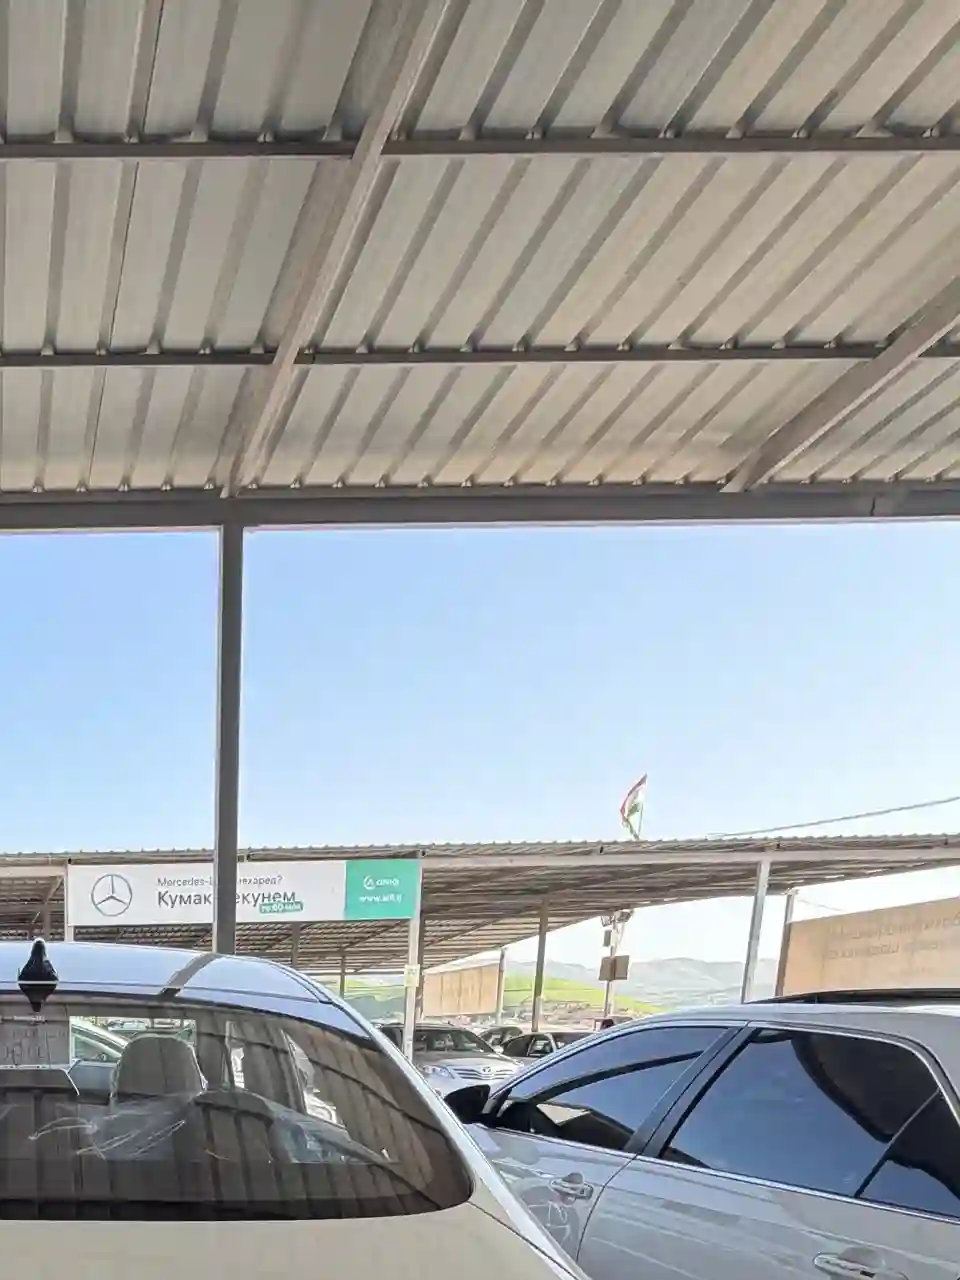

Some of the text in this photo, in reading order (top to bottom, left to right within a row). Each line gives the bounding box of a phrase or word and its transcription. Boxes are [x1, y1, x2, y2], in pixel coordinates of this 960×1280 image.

[238, 874, 283, 888] ехаред?
[158, 890, 296, 909] Кумак екунем
